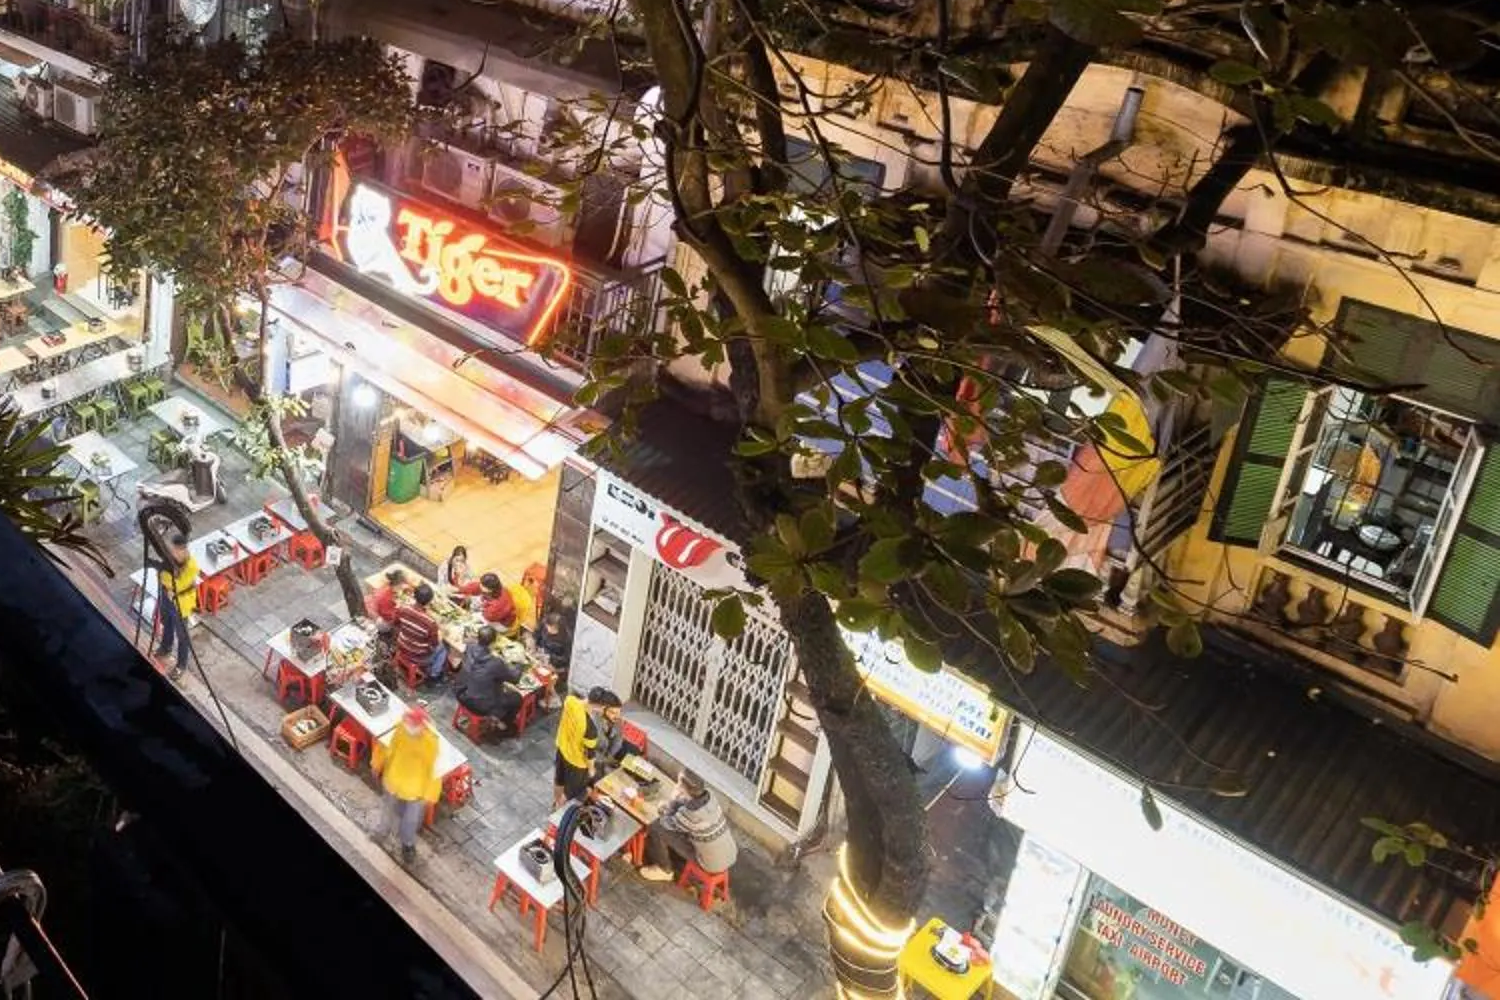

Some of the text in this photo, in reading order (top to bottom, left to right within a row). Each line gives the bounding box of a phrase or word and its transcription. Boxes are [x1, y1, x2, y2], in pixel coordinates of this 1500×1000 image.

[397, 208, 534, 310] Tiger
[1096, 920, 1187, 986] TAXI AIRPORT
[1147, 930, 1205, 977] SERVICE
